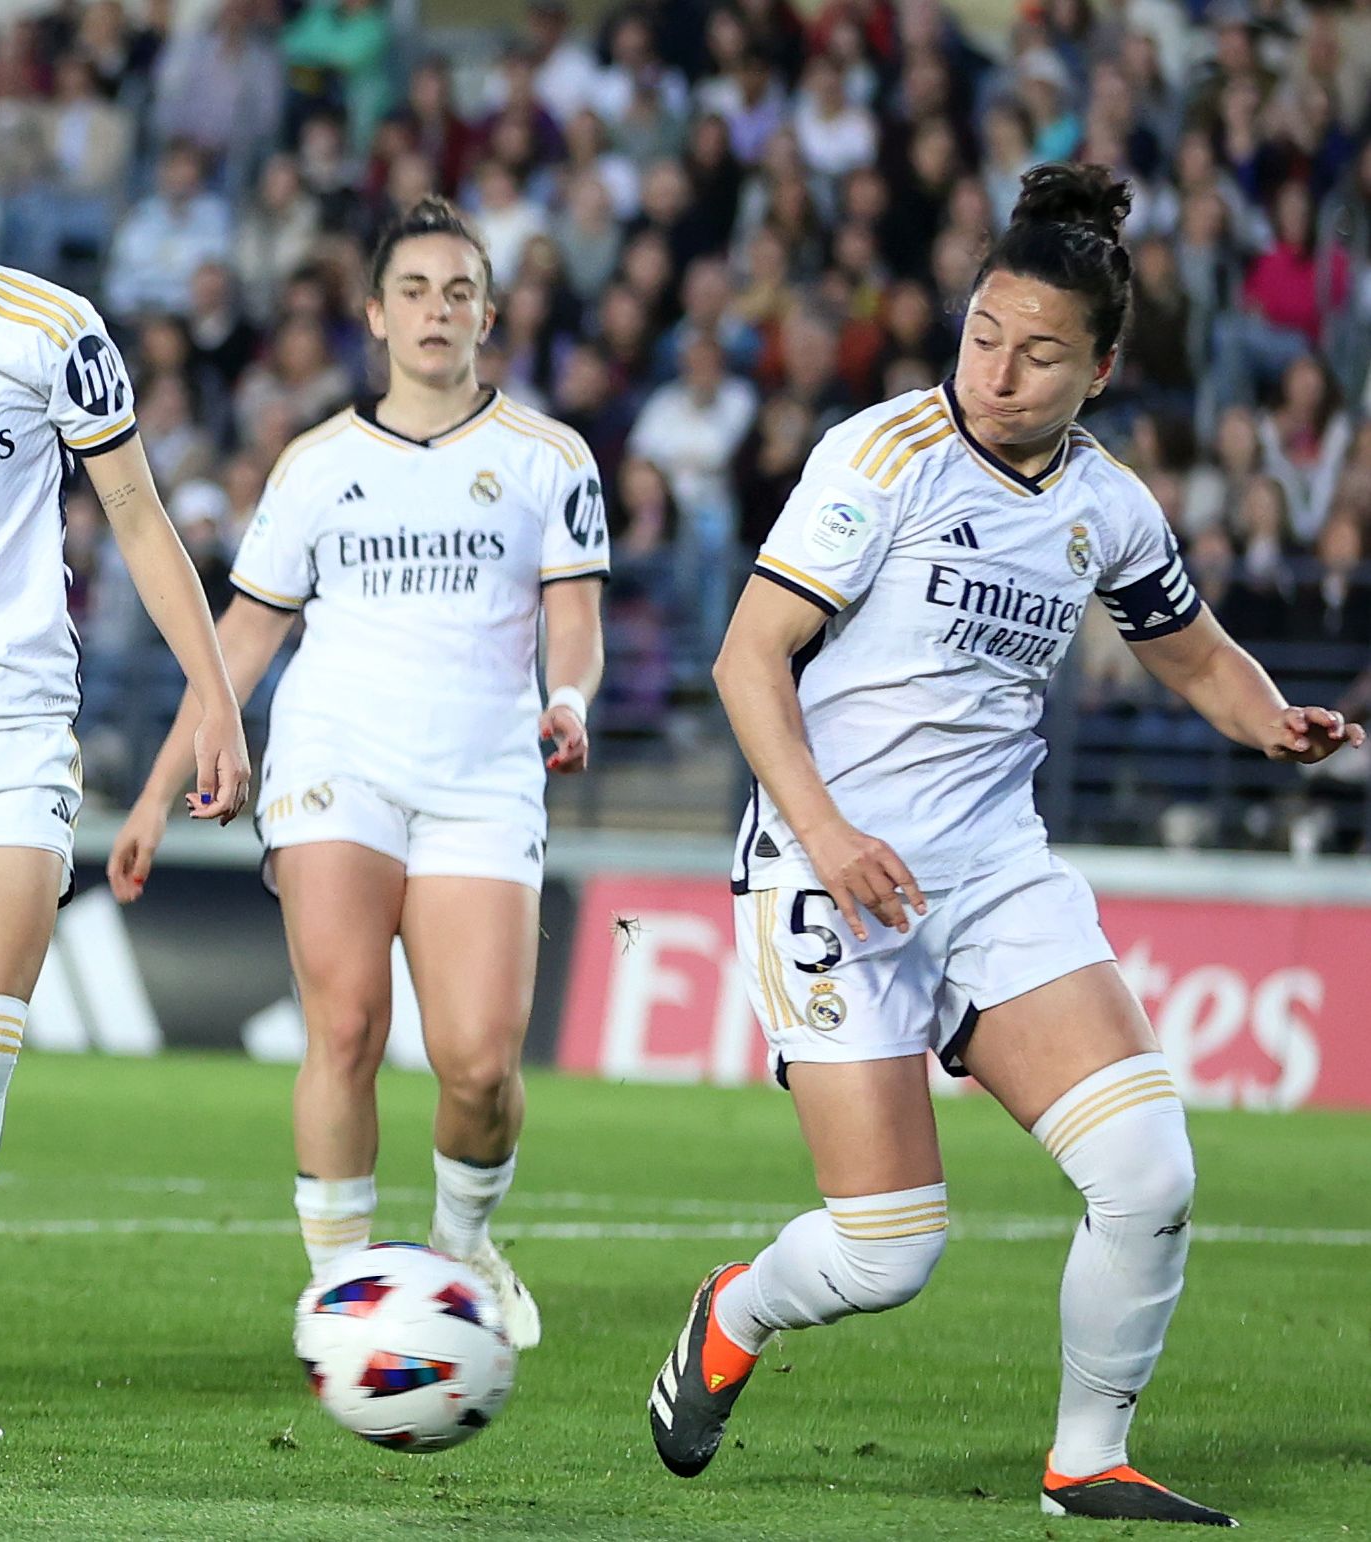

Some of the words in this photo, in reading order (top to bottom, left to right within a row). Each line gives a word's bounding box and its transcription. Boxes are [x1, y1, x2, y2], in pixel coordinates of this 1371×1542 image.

[339, 525, 506, 567] Emirates
[363, 568, 392, 600] FLY
[401, 563, 478, 595] BETTER
[942, 617, 990, 654] FLY
[985, 627, 1059, 668] BETTER
[791, 888, 843, 974] 5
